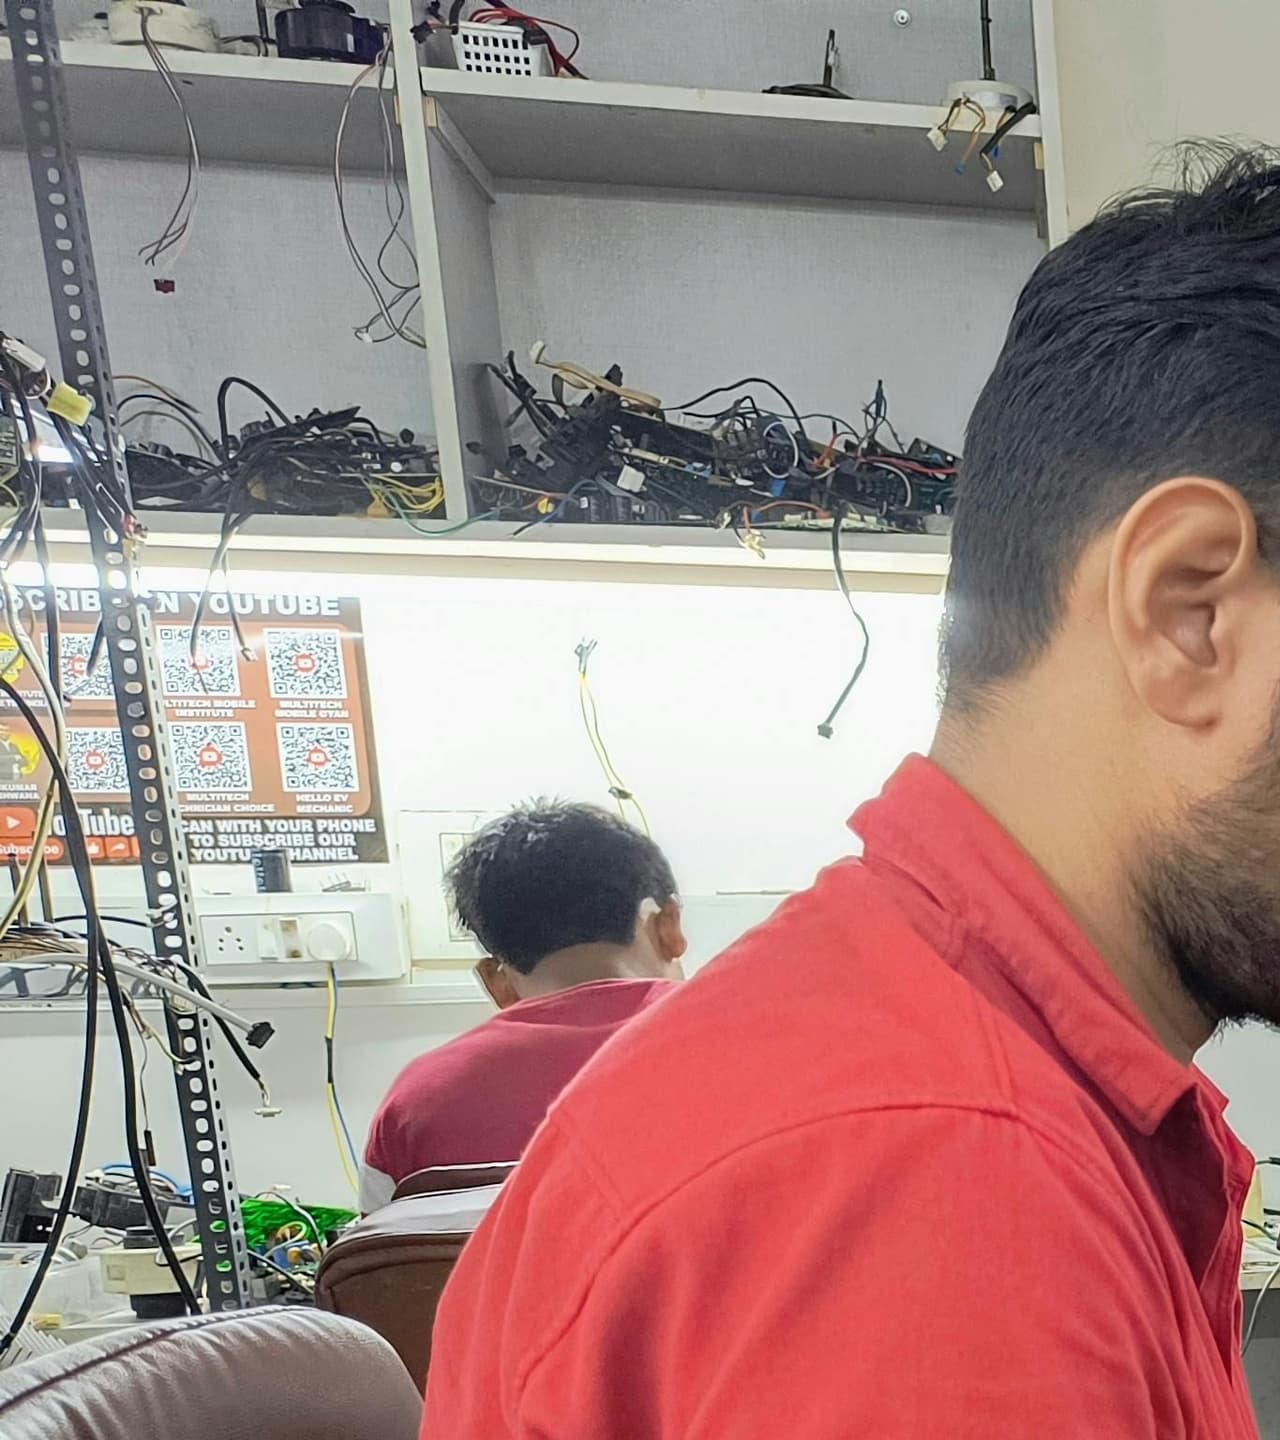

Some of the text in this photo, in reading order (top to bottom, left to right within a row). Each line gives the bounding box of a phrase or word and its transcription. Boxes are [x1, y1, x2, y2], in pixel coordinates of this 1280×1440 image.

[215, 819, 263, 834] WITH
[265, 819, 314, 834] YOUR
[315, 818, 377, 833] PHONE
[190, 833, 357, 848] TO SUBSCRIBE OUR
